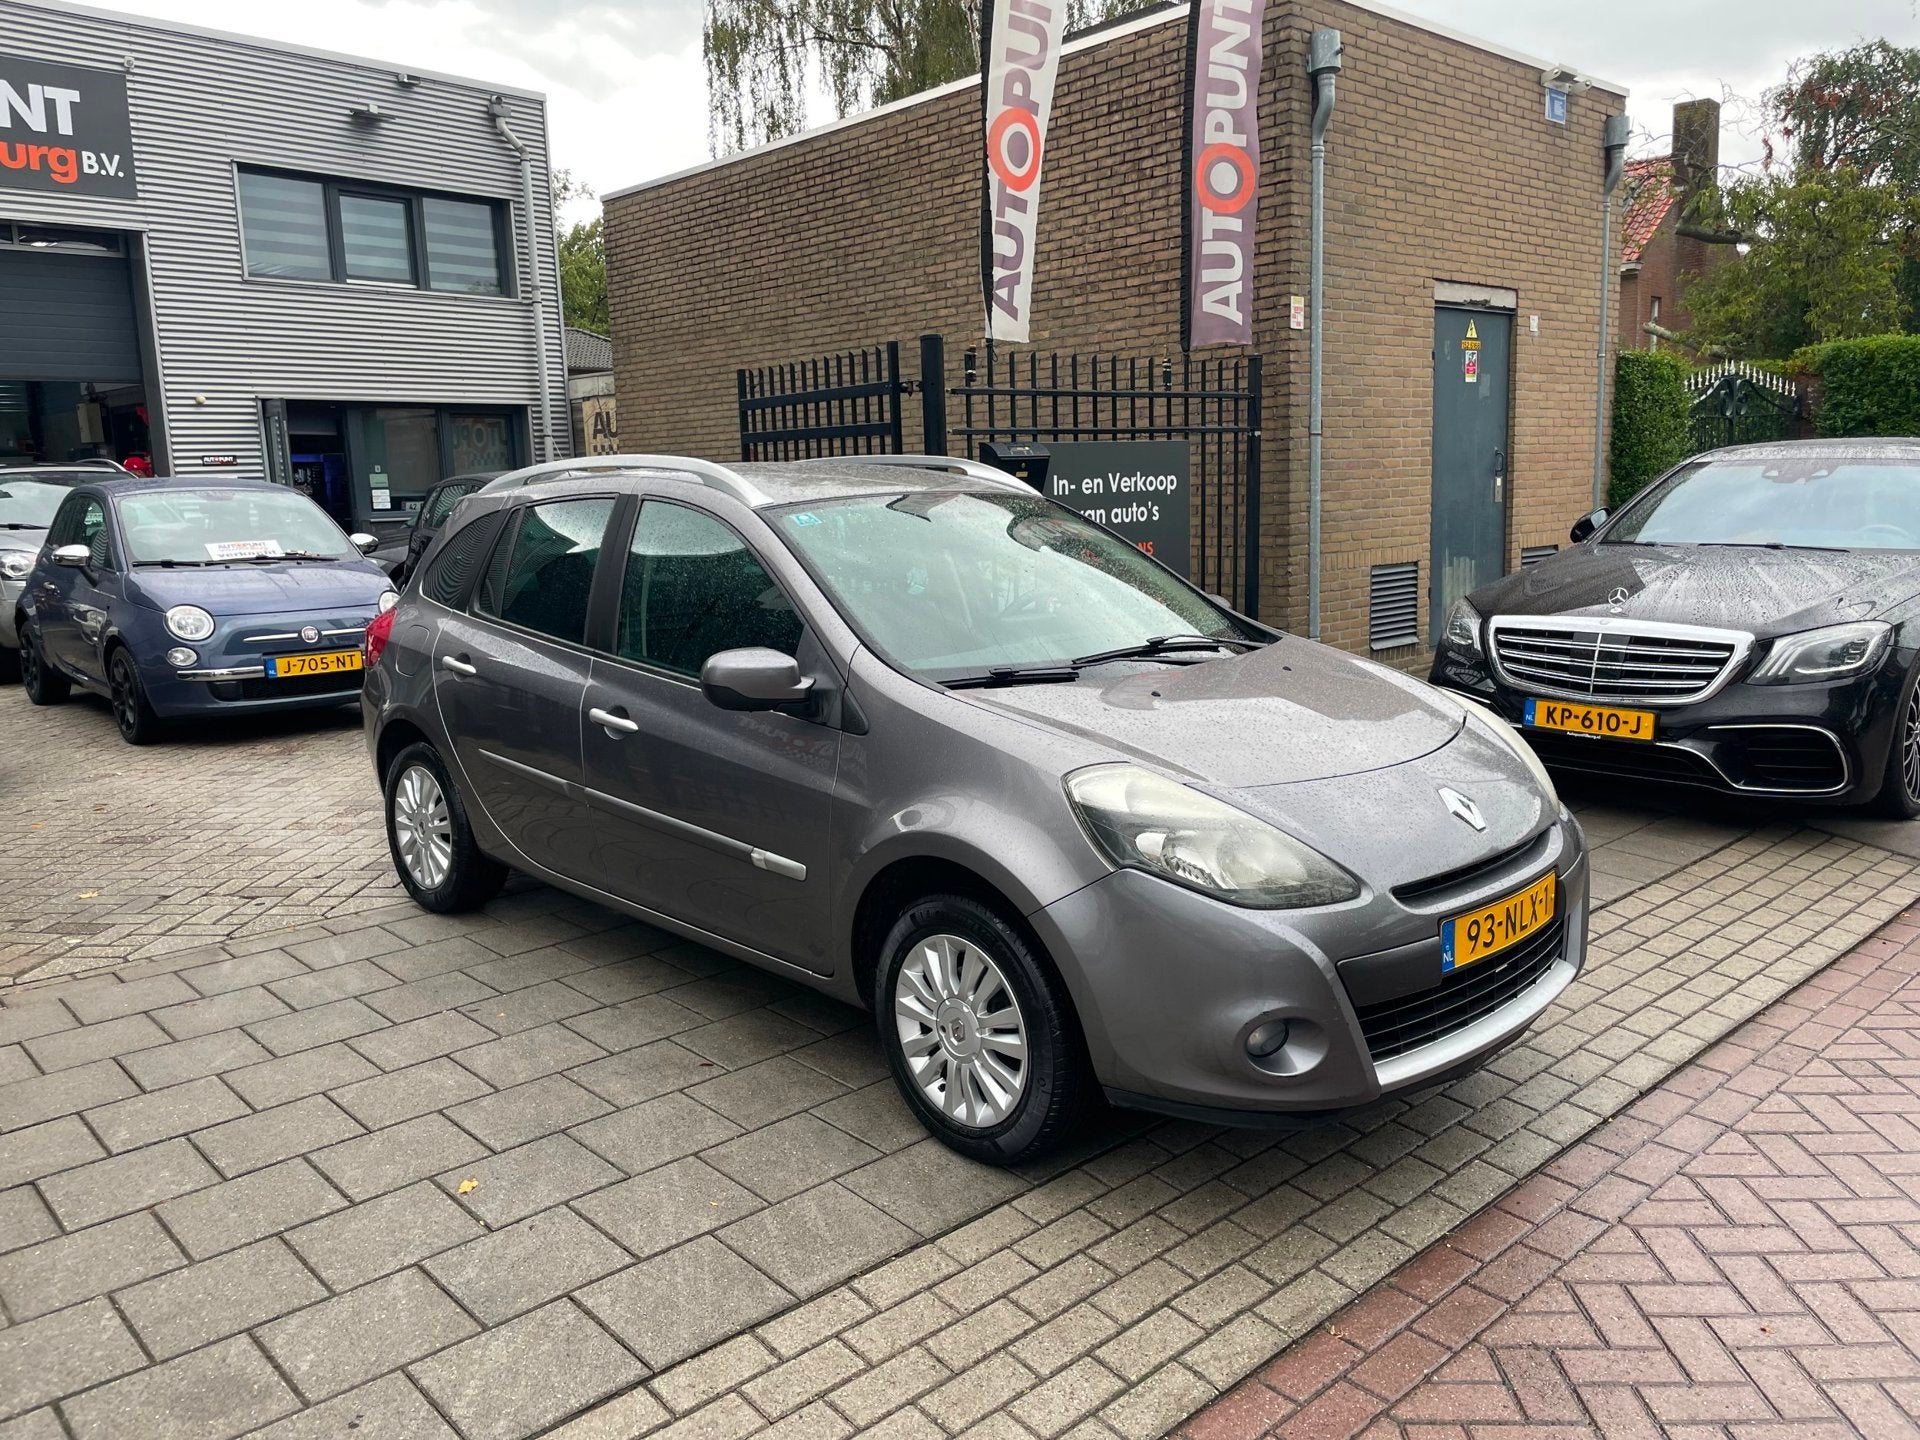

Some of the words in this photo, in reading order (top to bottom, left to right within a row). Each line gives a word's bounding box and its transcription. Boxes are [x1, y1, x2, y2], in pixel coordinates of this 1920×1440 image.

[82, 151, 125, 178] B.V.
[1053, 475, 1076, 495] In-
[1082, 477, 1103, 494] en
[1108, 472, 1177, 495] Verkoop
[1081, 508, 1106, 524] an
[1111, 501, 1160, 523] auto's
[283, 654, 356, 674] J-705-NT
[1545, 705, 1641, 735] KP-610-J
[1467, 883, 1549, 955] 93-NLX-1
[1443, 952, 1454, 963] NL
